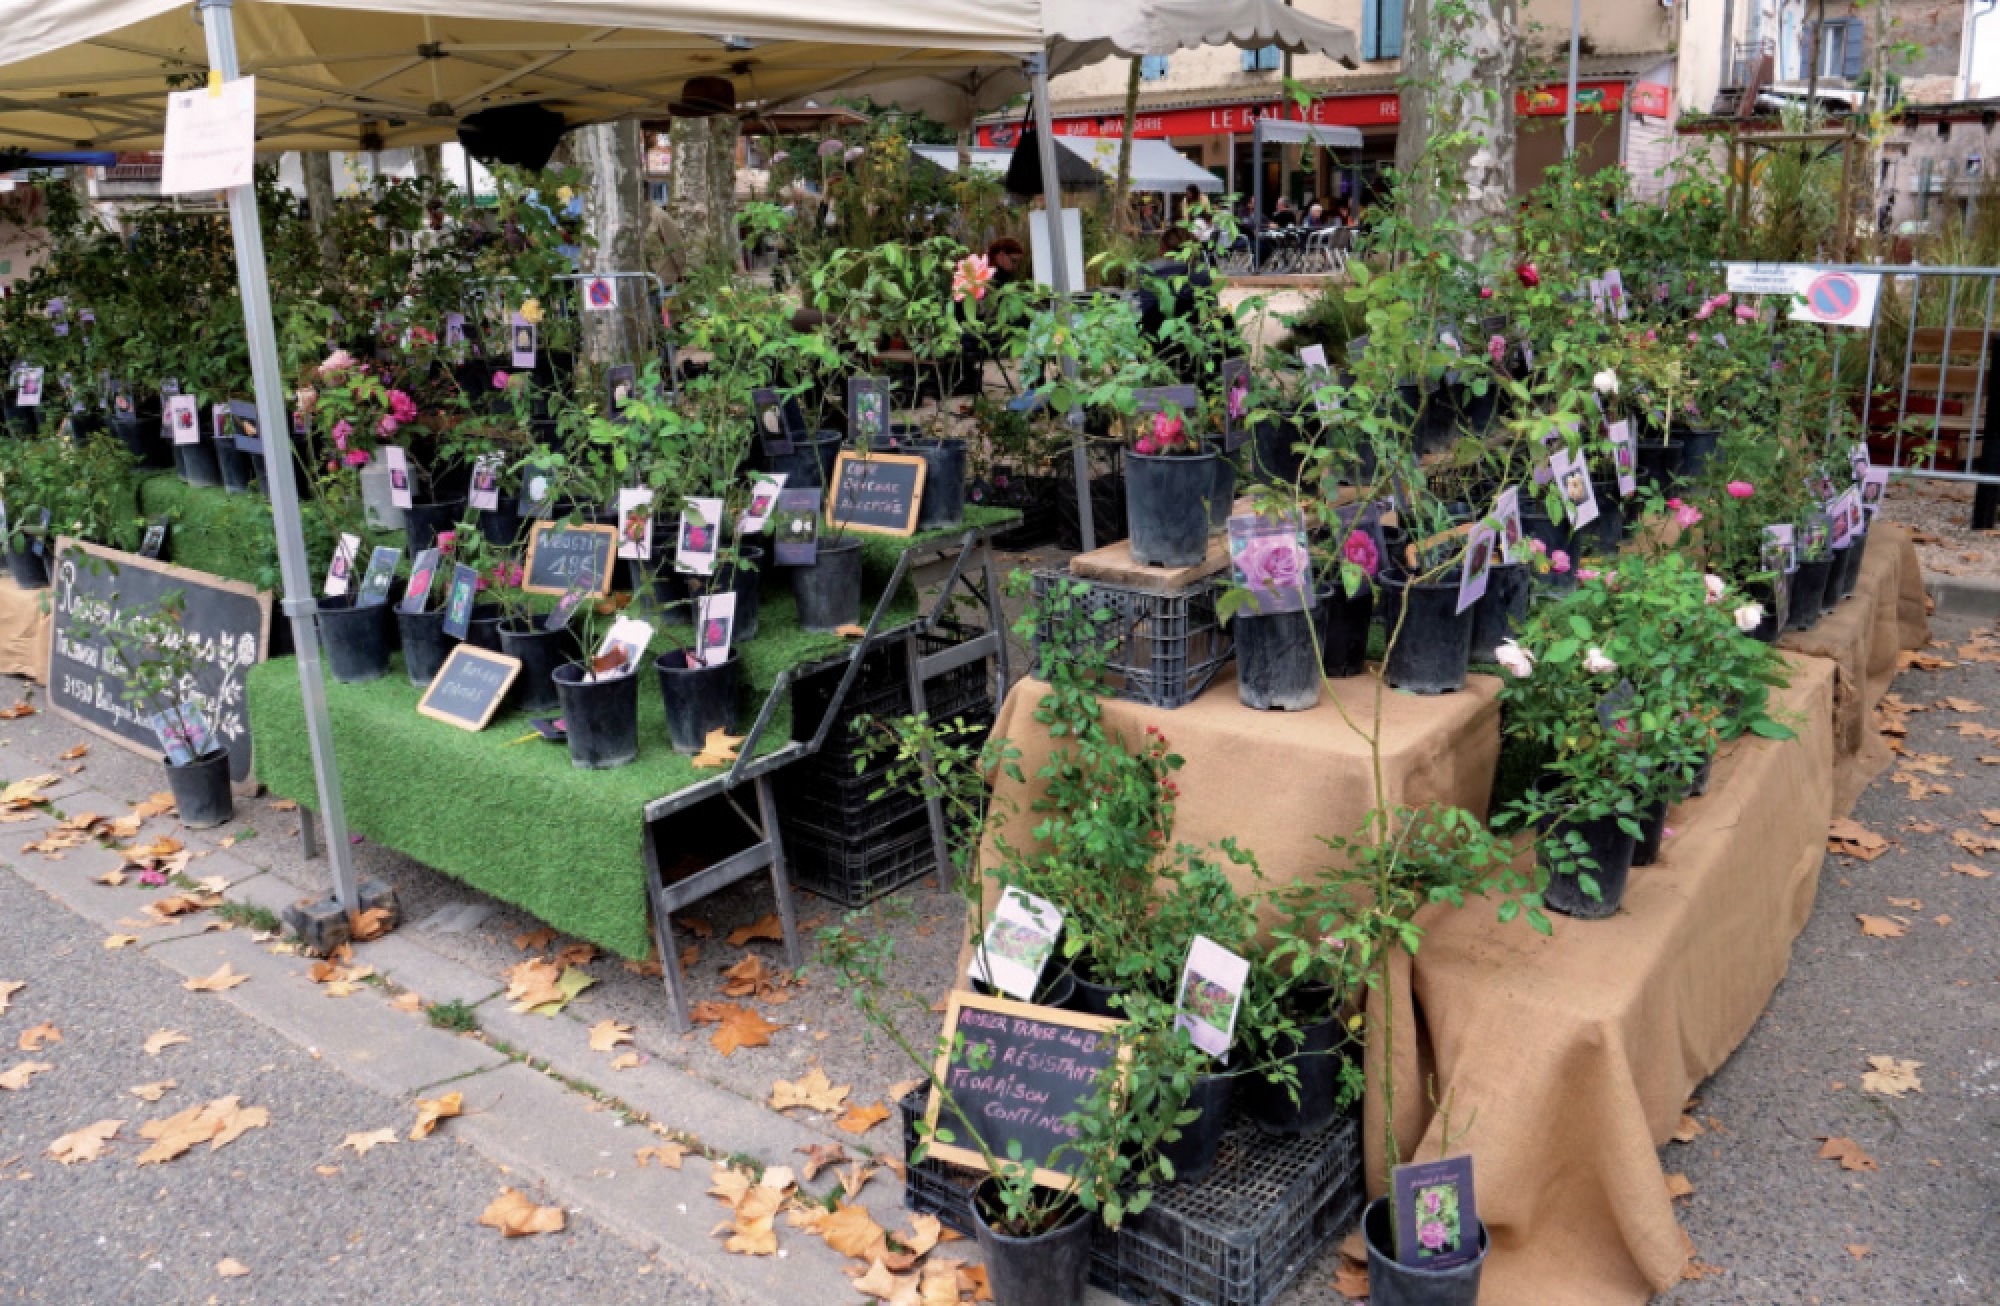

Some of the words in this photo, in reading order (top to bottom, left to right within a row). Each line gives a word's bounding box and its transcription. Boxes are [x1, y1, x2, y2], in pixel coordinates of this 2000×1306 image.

[1066, 121, 1088, 136] BAR
[1100, 117, 1162, 133] BRASERIE
[1211, 110, 1233, 129] LE
[1242, 104, 1325, 128] RALYE
